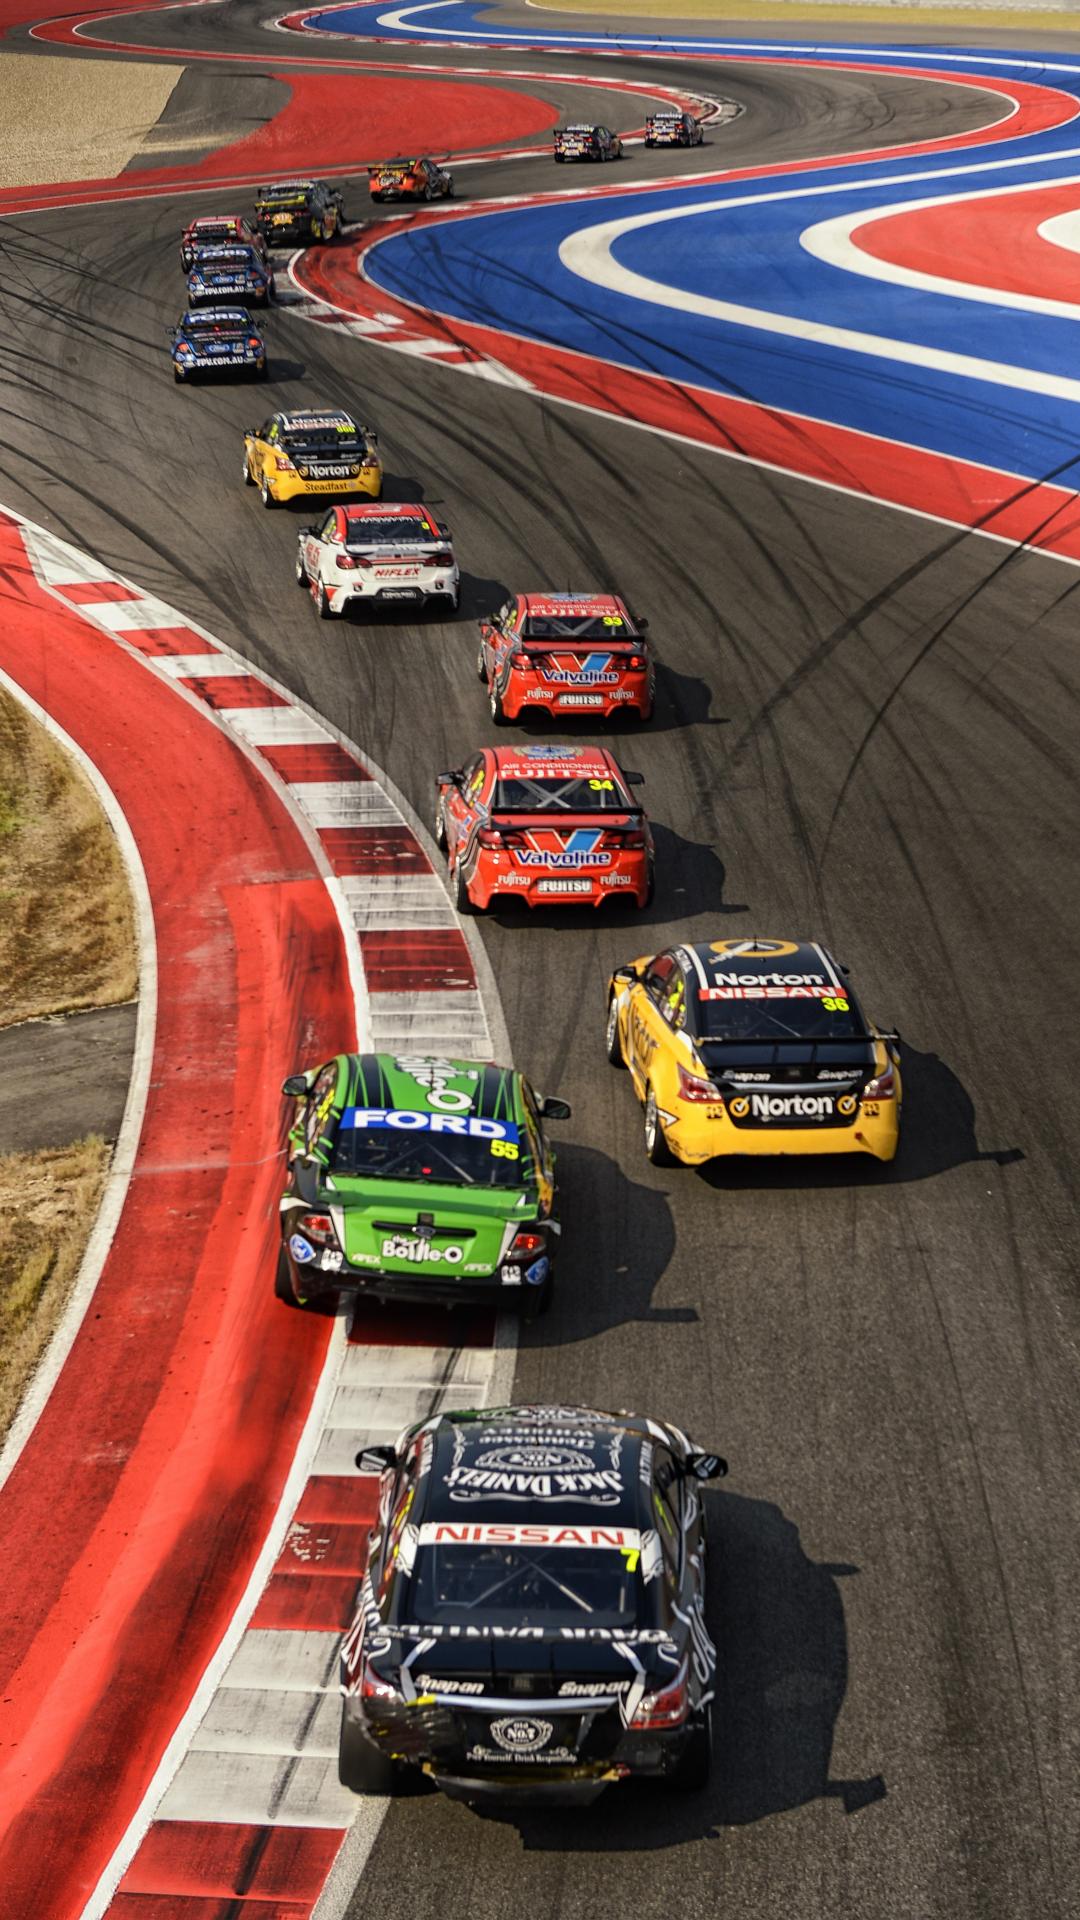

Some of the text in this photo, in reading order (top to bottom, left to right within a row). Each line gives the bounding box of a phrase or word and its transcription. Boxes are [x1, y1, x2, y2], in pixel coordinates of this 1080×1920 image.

[309, 465, 350, 477] Norton
[304, 482, 348, 492] Steadfast
[602, 616, 623, 626] 33
[542, 669, 619, 682] Valvoline
[526, 688, 554, 699] FUJITSU
[563, 695, 602, 704] FUJITSU
[609, 689, 635, 699] FUJITSU
[522, 762, 607, 770] CONDITIONING
[500, 769, 610, 778] FUJITSU
[588, 779, 614, 791] 34
[514, 849, 611, 865] Valvoline
[497, 873, 531, 886] FUJITSU
[543, 880, 592, 892] FUJITSU
[600, 873, 632, 886] FUJITSU
[714, 972, 823, 986] Norton
[709, 987, 838, 1000] NISSAN
[821, 997, 850, 1012] 36
[751, 1094, 834, 1115] Norton
[354, 1110, 507, 1139] FORD
[490, 1139, 519, 1160] 55
[553, 1469, 626, 1494] JACK
[434, 1525, 626, 1546] NISSAN
[619, 1547, 641, 1573] 7
[415, 1673, 485, 1695] Snap-on
[557, 1680, 631, 1698] Snap-on
